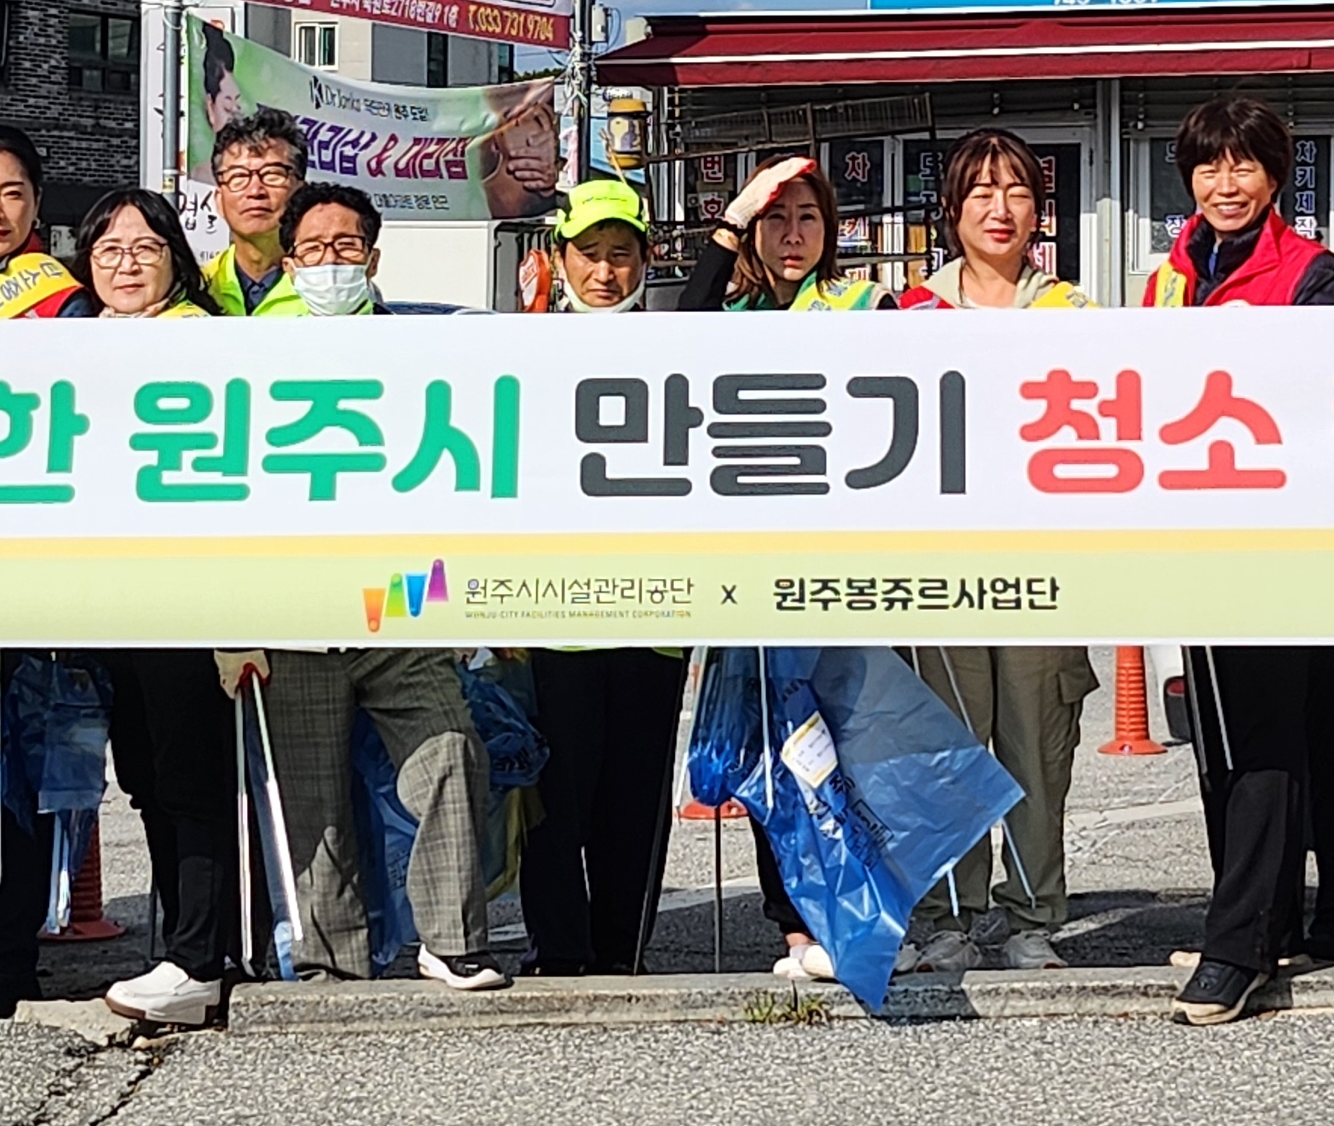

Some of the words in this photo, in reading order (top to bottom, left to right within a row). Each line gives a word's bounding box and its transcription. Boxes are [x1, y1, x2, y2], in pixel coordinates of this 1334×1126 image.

[128, 374, 522, 504] 원주시
[574, 370, 967, 497] 만들기
[1019, 368, 1287, 494] 청소
[464, 577, 696, 605] 원주시시설관리공단
[772, 576, 1061, 612] 원주봉쥬르사업단
